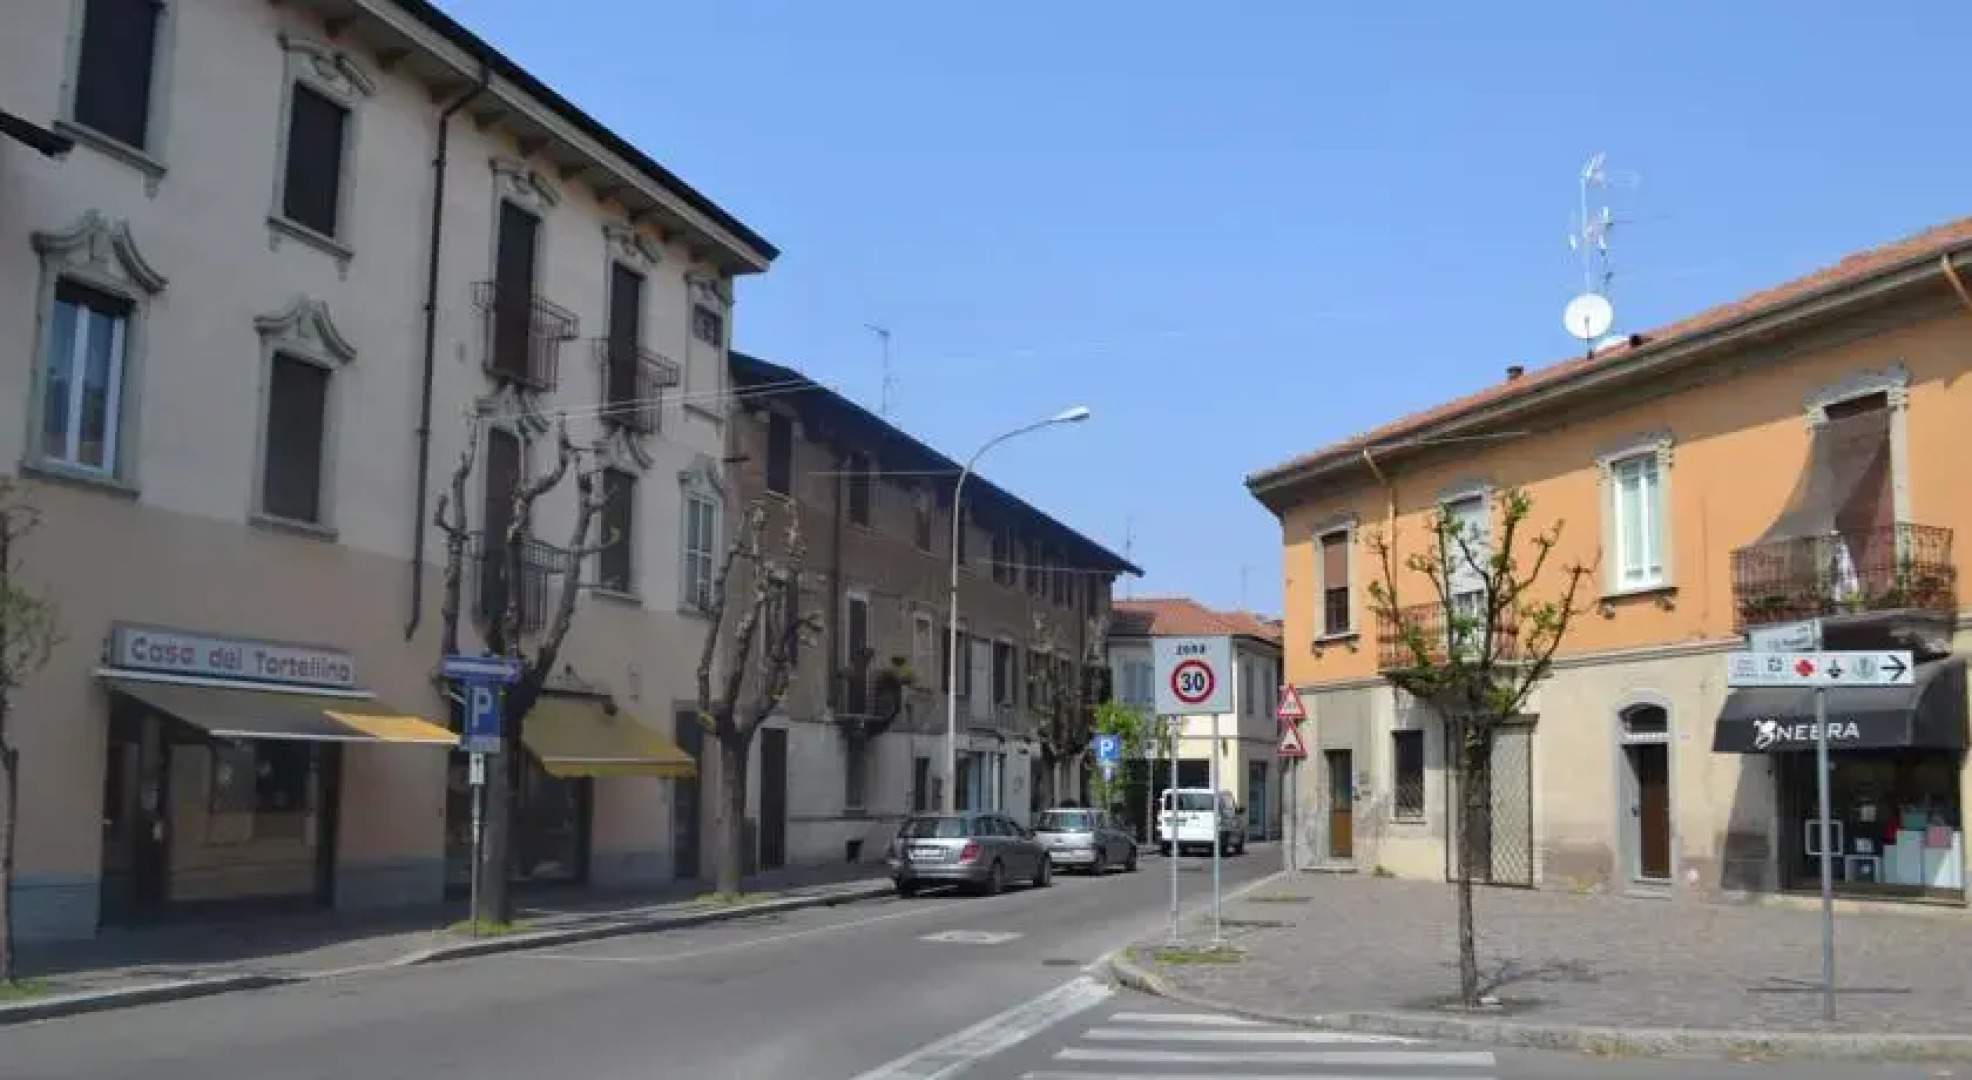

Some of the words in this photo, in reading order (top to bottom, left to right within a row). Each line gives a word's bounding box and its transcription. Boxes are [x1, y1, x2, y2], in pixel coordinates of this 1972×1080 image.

[1175, 643, 1206, 655] zona
[131, 637, 195, 665] Casa
[208, 647, 243, 670] del
[254, 650, 350, 682] Tortellino
[1181, 673, 1205, 690] 30
[471, 687, 493, 728] P
[1100, 739, 1114, 759] P
